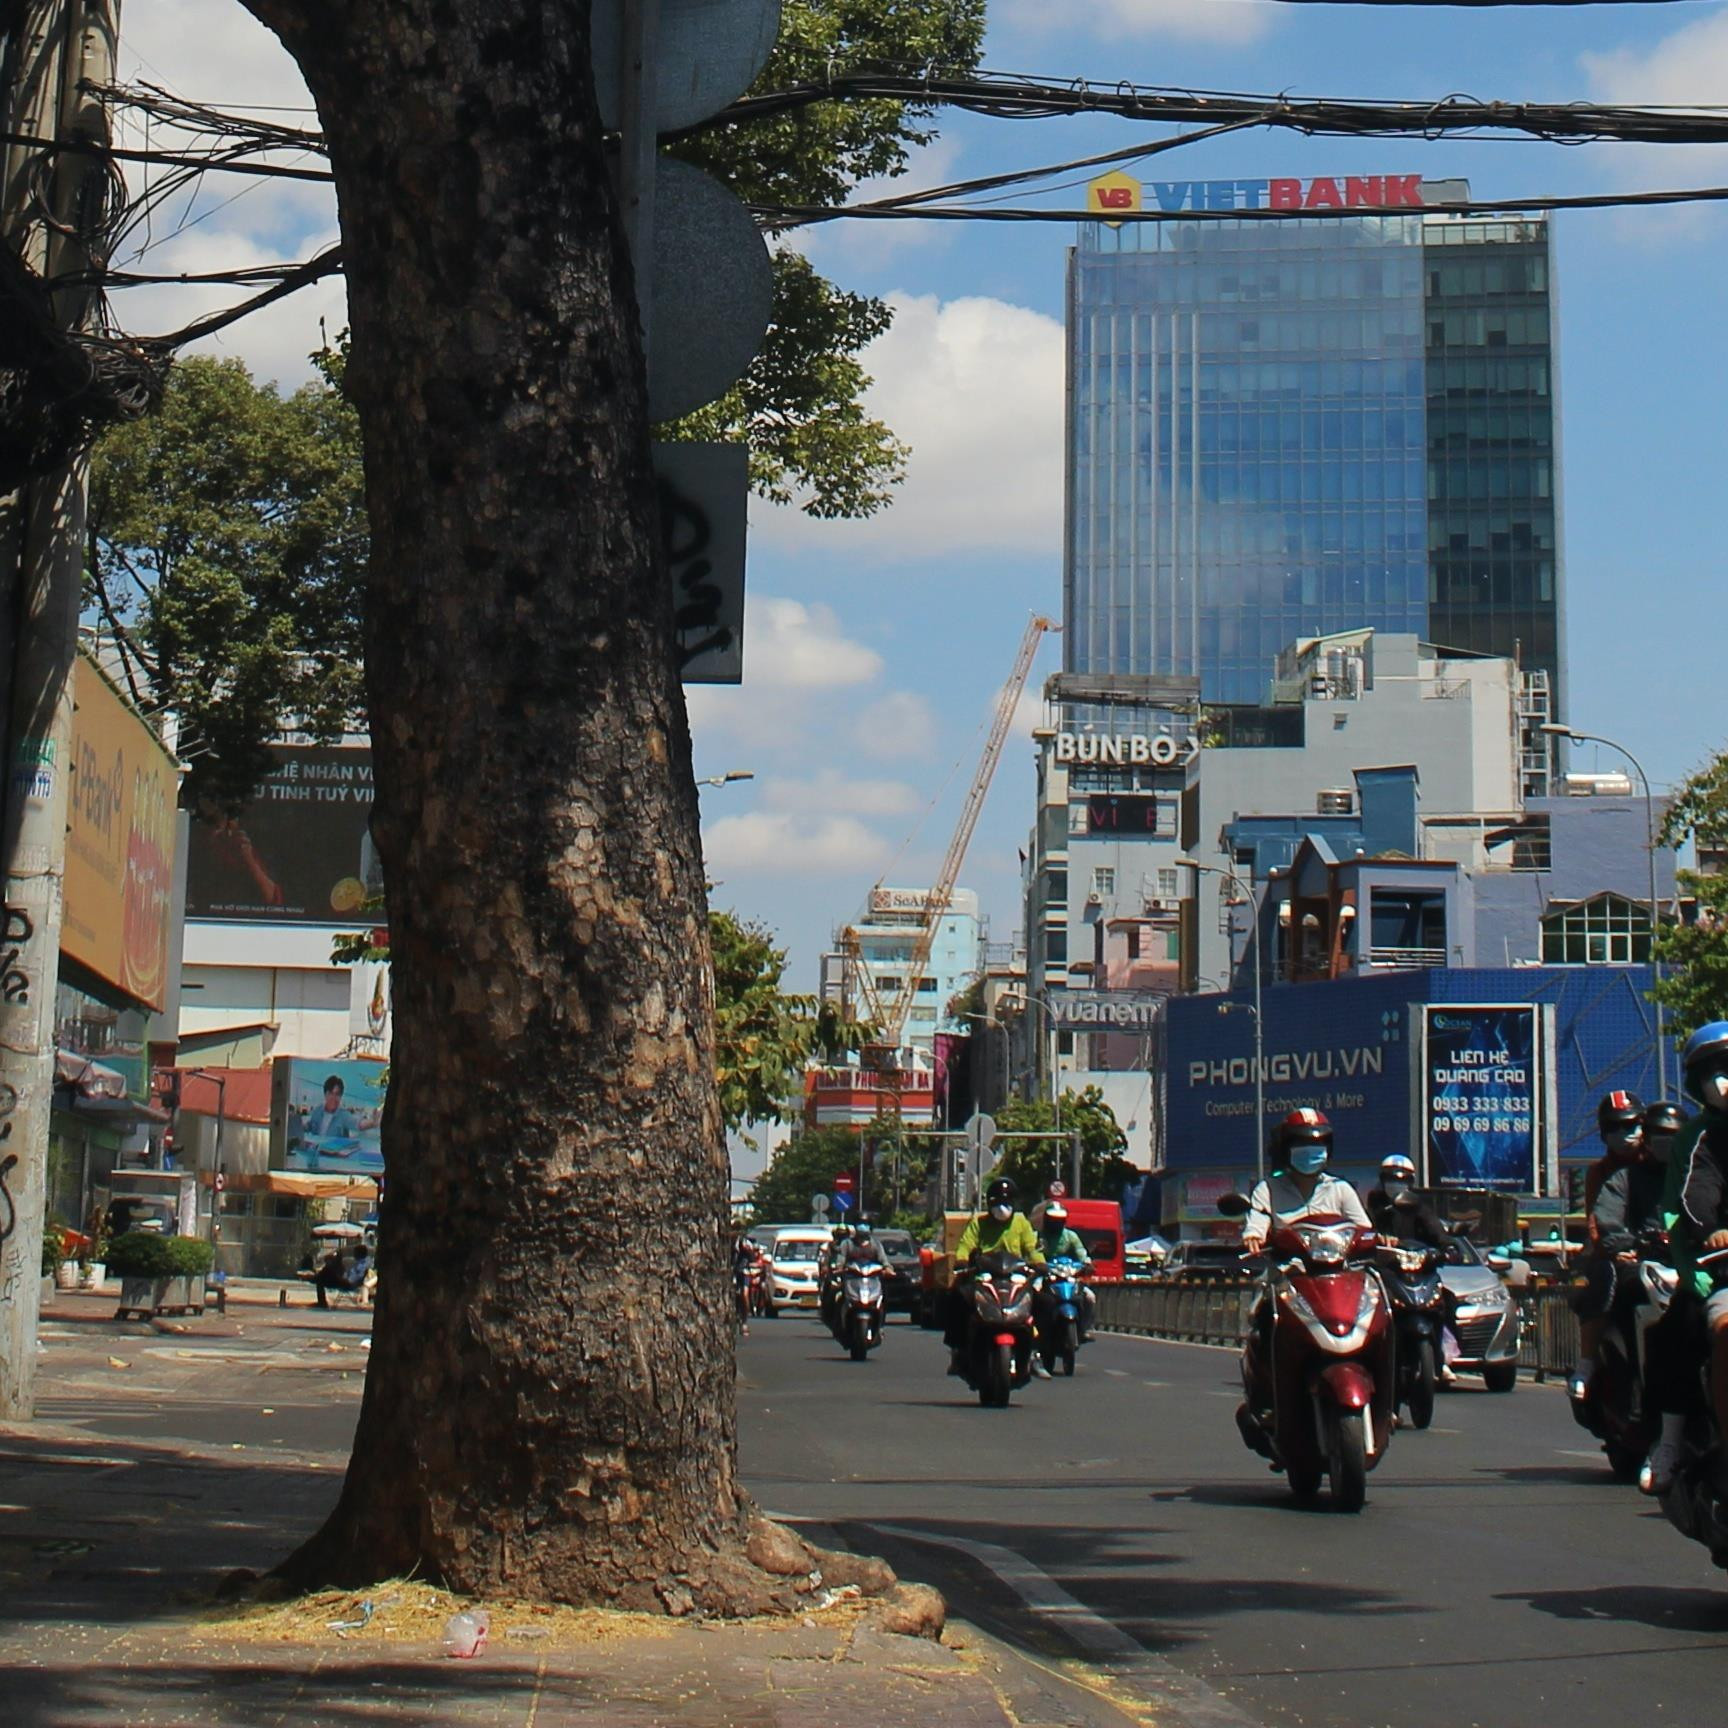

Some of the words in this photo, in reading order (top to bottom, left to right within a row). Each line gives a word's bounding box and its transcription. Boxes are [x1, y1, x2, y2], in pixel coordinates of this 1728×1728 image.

[1096, 187, 1133, 209] VB
[1153, 175, 1423, 210] VIETBANK
[1057, 724, 1122, 763] BÚN
[1131, 725, 1177, 765] BÒ
[1189, 1046, 1382, 1088] PHONGVU.VN
[1336, 1092, 1365, 1109] More
[1433, 1096, 1469, 1112] 0933
[1472, 1096, 1500, 1112] 333
[1503, 1096, 1530, 1112] 833
[1433, 1117, 1451, 1132] 09
[1453, 1117, 1471, 1132] 69
[1473, 1117, 1491, 1132] 69
[1493, 1117, 1511, 1132] 86
[1513, 1117, 1530, 1132] 86
